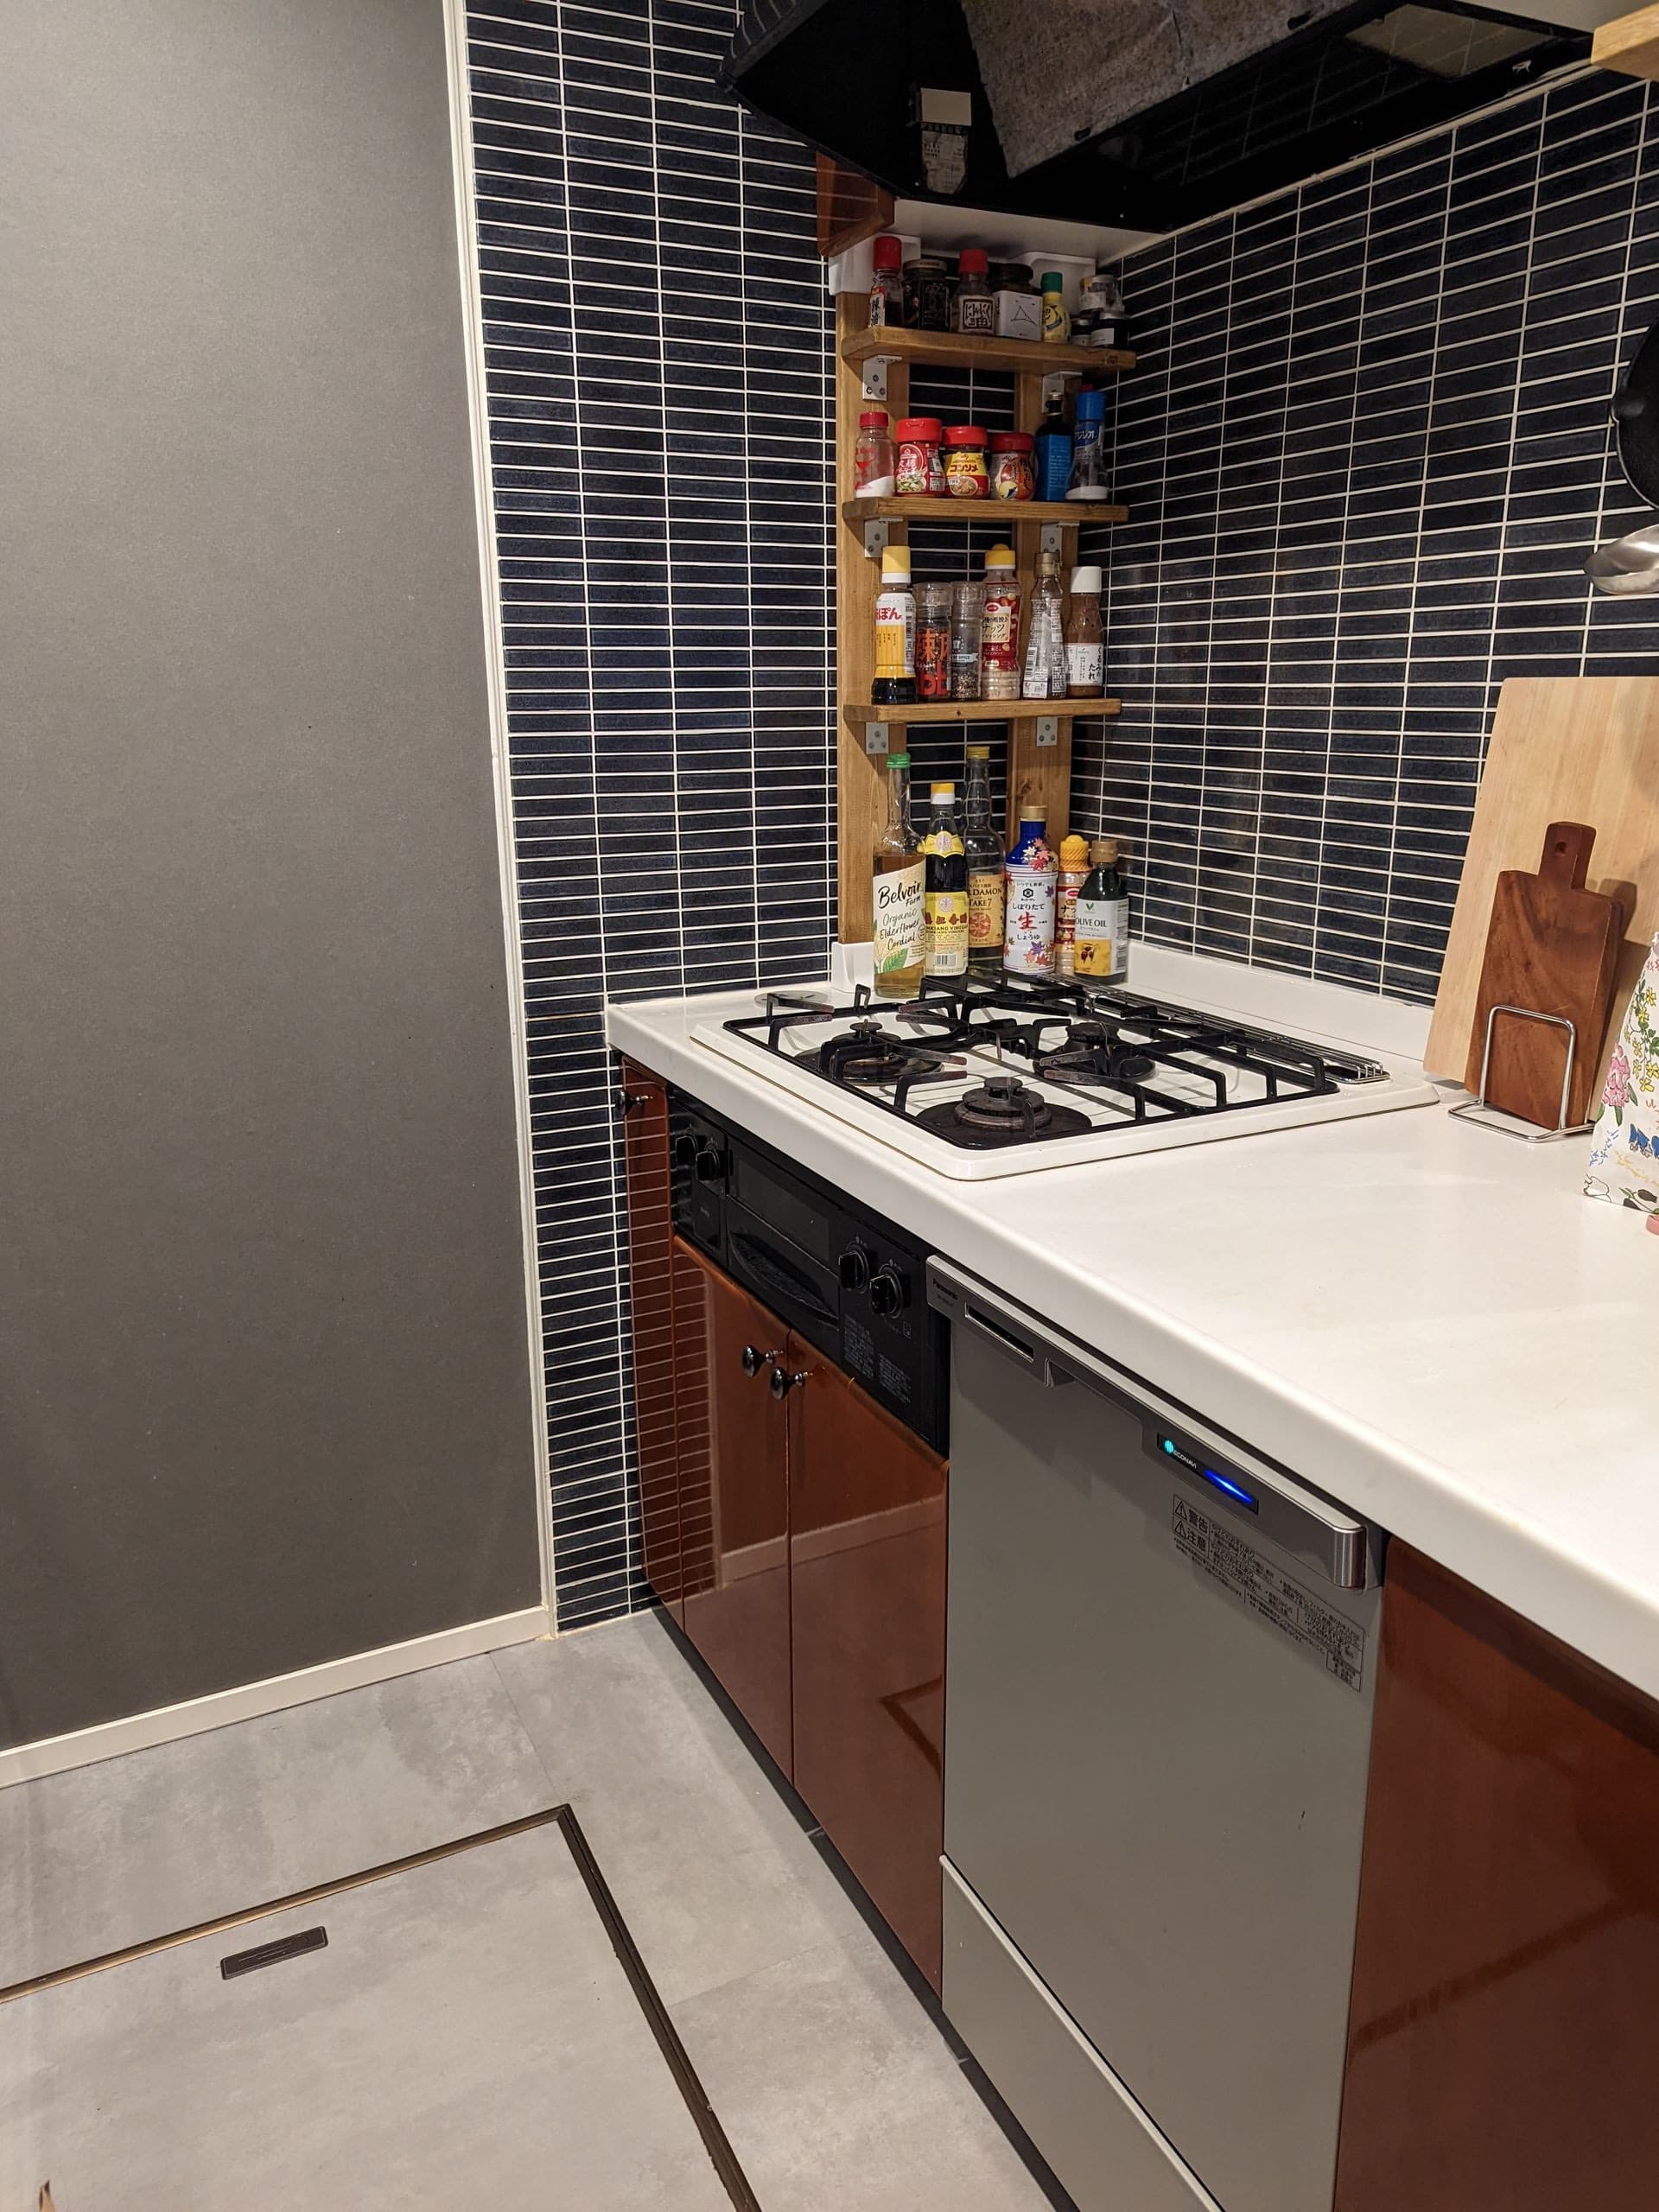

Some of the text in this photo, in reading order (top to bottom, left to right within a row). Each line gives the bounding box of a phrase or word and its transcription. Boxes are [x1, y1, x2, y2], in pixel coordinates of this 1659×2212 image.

[950, 463, 978, 473] コンソメ
[878, 880, 921, 909] Belvoir
[906, 895, 921, 907] Farm
[968, 887, 1002, 896] RDAMON
[882, 908, 918, 927] Organic
[1018, 912, 1038, 930] 生
[1075, 917, 1093, 926] OLIVE
[880, 918, 920, 940] Elderflower
[887, 932, 916, 951] Cordial
[1189, 1508, 1208, 1534] 警告
[1186, 1527, 1206, 1552] 注意
